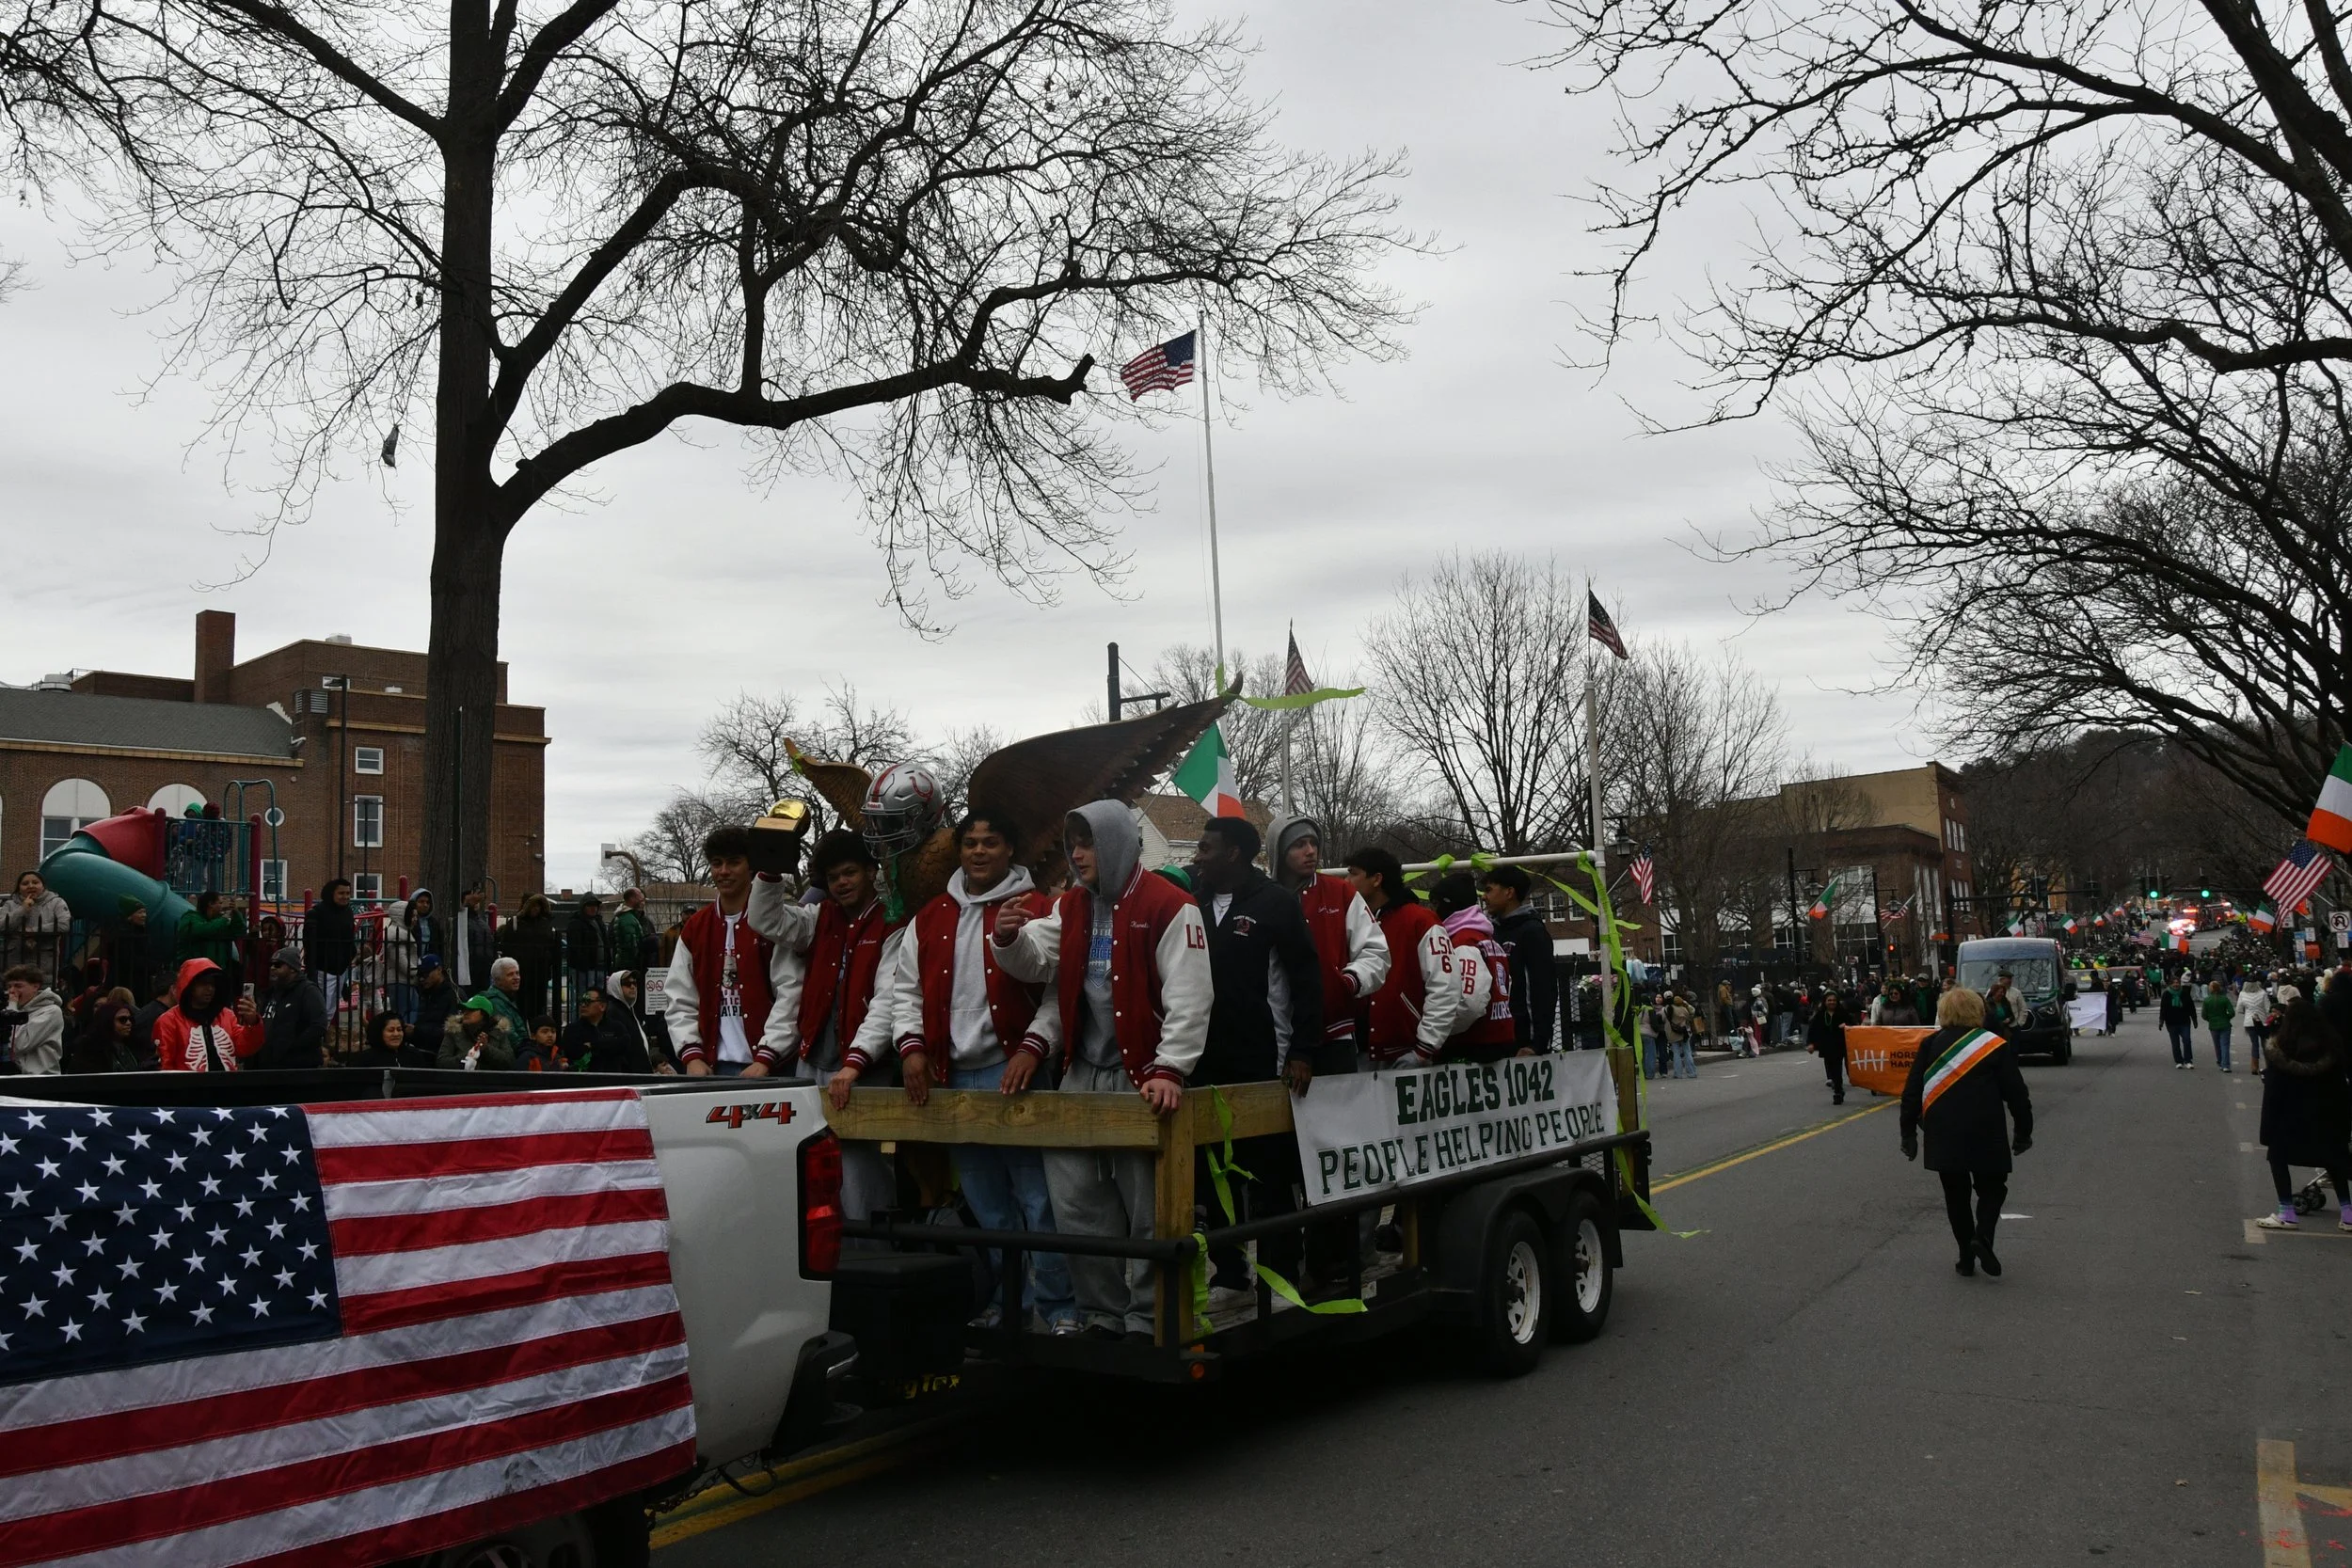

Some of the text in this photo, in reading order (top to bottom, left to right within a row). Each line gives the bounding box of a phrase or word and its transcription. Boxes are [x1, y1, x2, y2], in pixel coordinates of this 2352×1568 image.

[1186, 924, 1205, 949] LB
[1441, 955, 1453, 974] 6
[1461, 976, 1475, 995] B
[1890, 1051, 1917, 1059] HORS
[1891, 1060, 1914, 1069] HAR
[1396, 1059, 1555, 1125] EAGLES 1042
[706, 1101, 797, 1129] 4x4
[1318, 1102, 1605, 1195] PEOPLE HELPING PEOPLE
